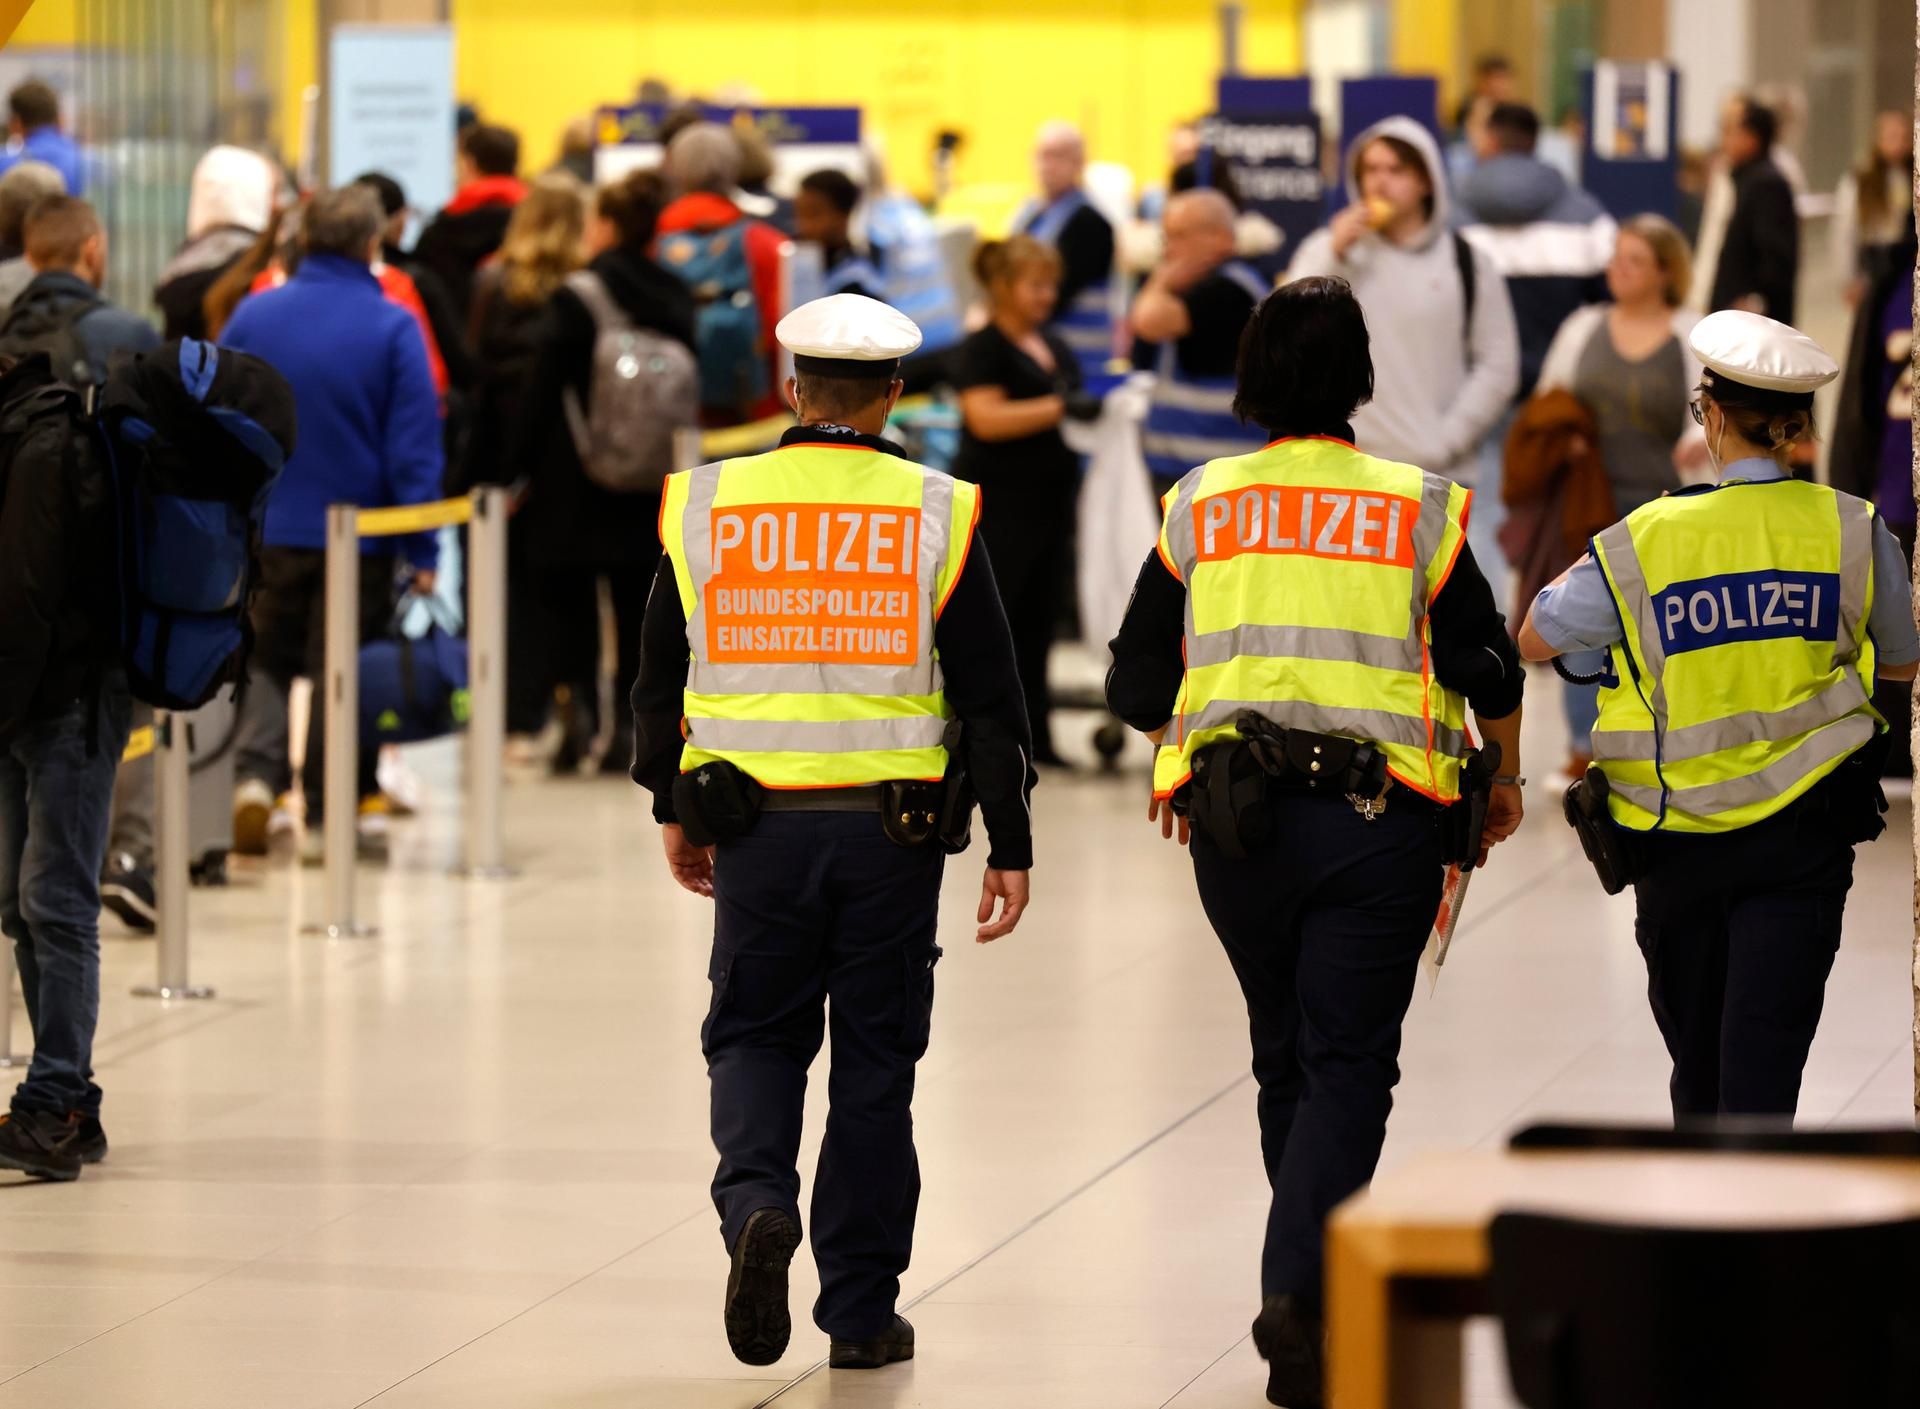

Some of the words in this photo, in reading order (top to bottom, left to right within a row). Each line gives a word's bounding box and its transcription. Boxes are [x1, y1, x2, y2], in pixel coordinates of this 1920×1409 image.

[711, 511, 915, 575] POLIZEI
[1203, 490, 1401, 560] POLIZEI
[716, 588, 909, 618] BUNDESPOLIZEI
[1664, 581, 1821, 641] POLIZEI
[717, 626, 907, 654] EINSATZLEITUNG
